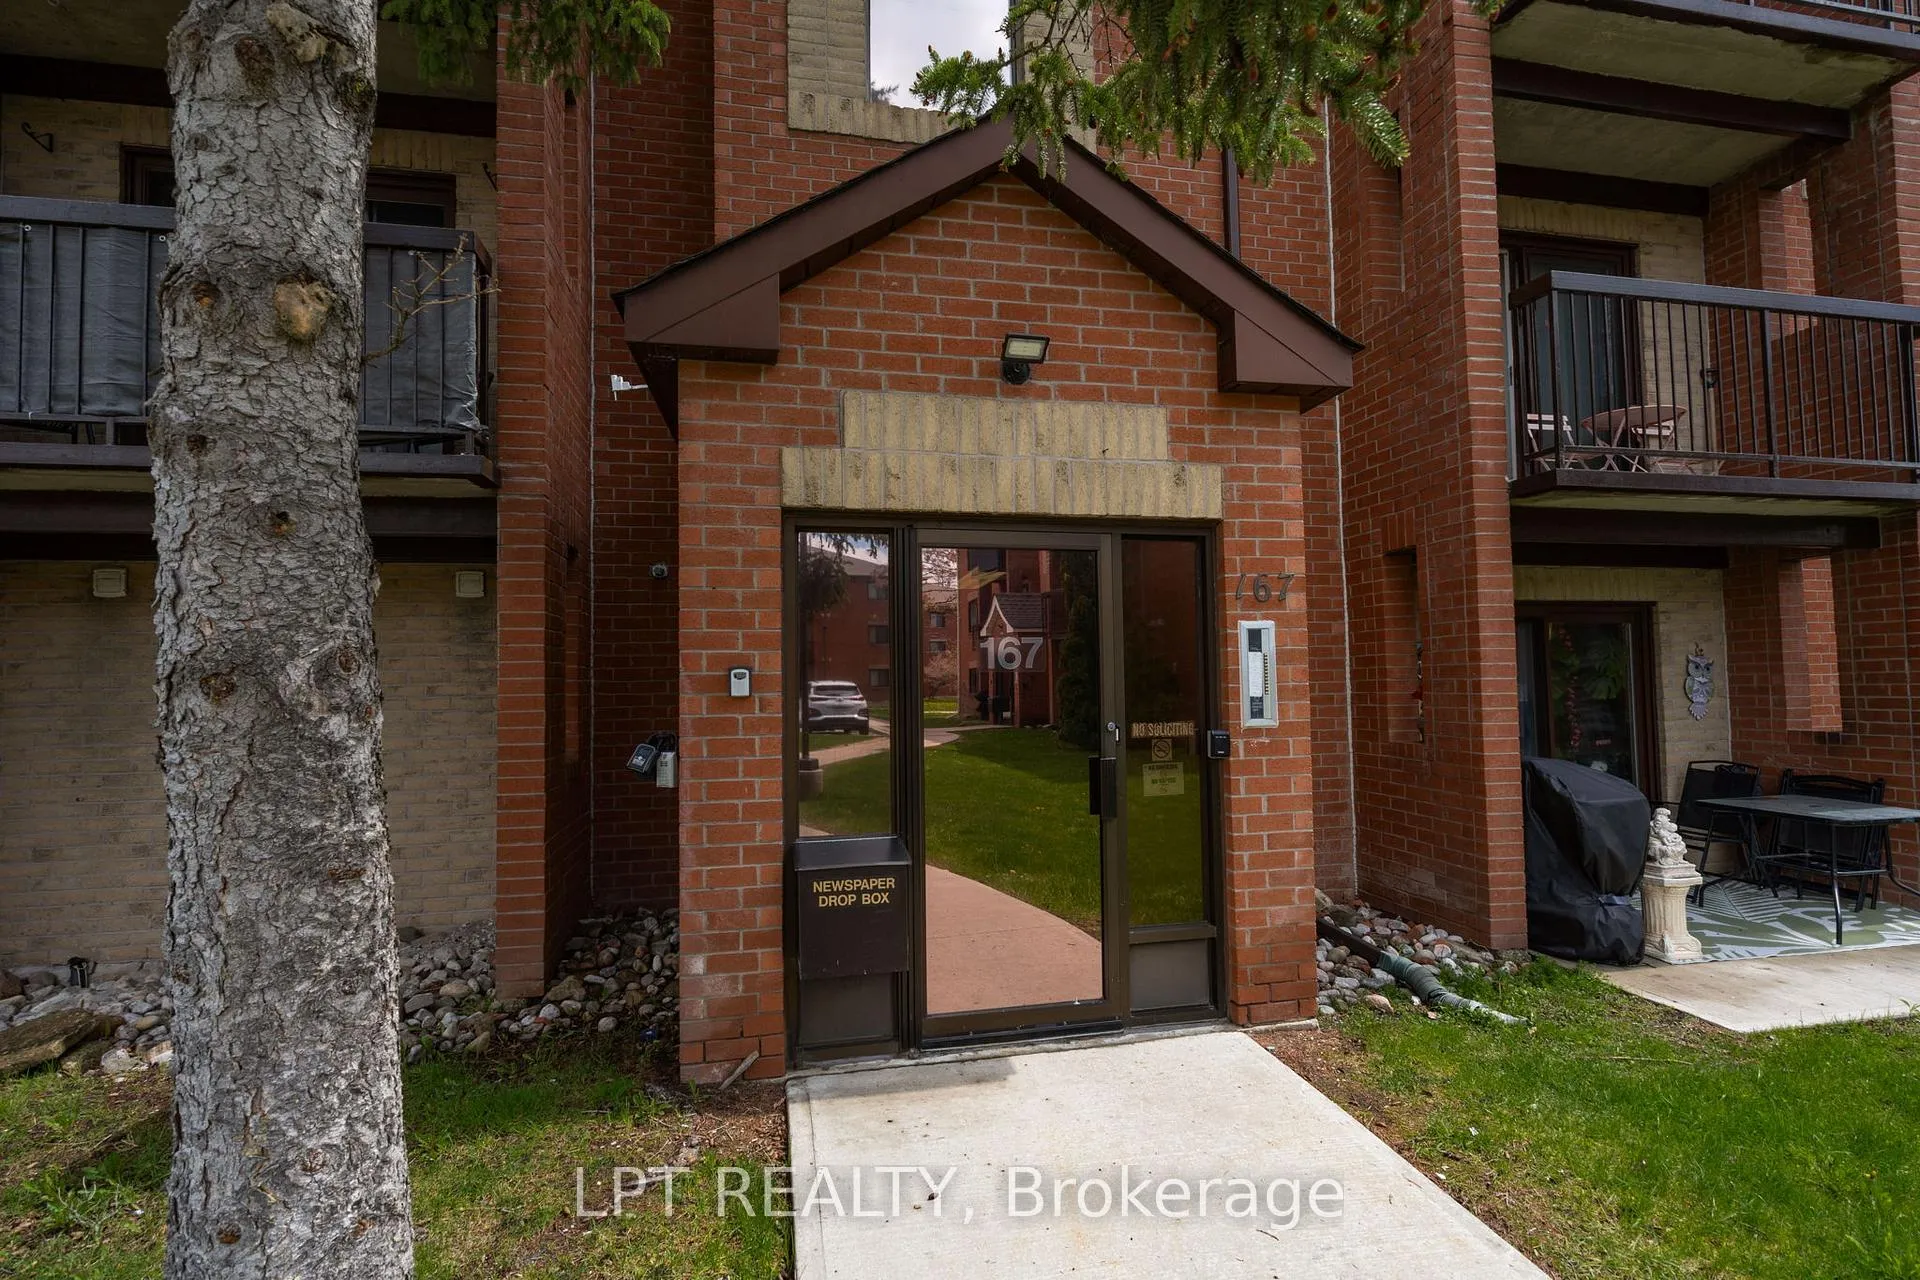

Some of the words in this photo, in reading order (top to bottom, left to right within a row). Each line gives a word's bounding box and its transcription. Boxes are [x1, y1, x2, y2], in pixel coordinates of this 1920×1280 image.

[1236, 573, 1295, 602] 167
[979, 636, 1044, 670] 167
[1132, 722, 1145, 737] NO
[1148, 721, 1194, 737] SOLICITING
[813, 877, 896, 893] NEWSPAPER
[818, 894, 857, 907] DROP
[861, 892, 890, 905] BOX
